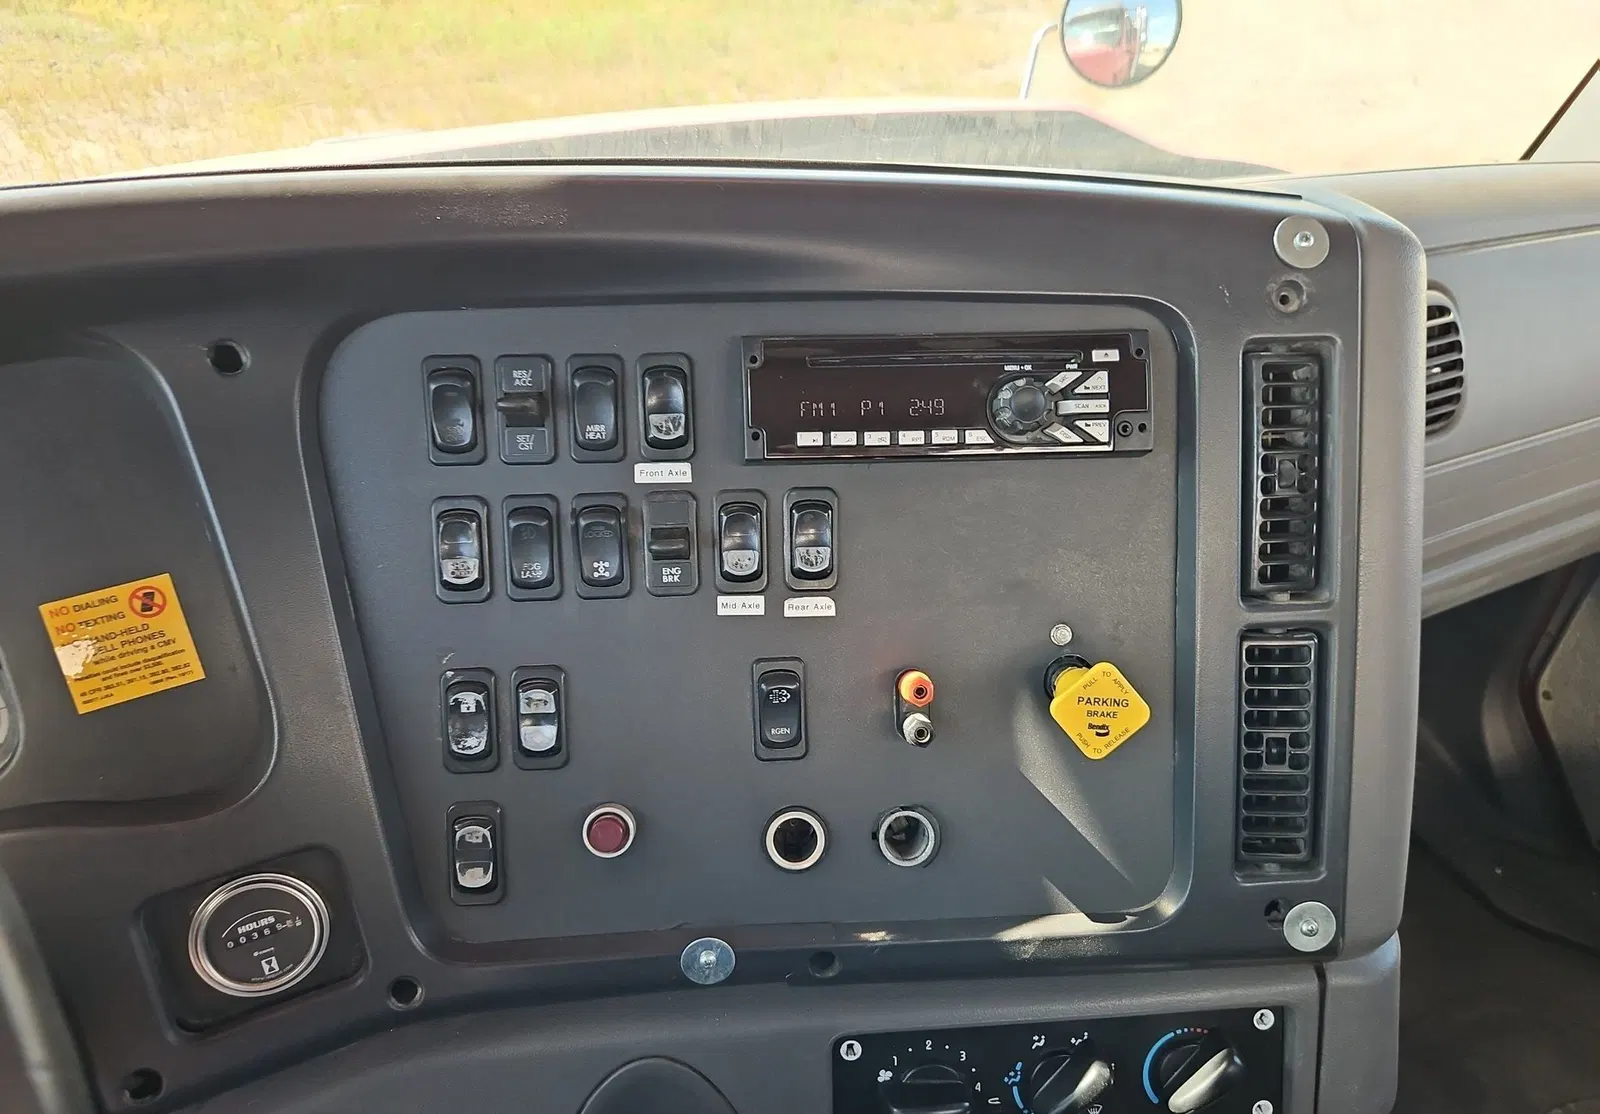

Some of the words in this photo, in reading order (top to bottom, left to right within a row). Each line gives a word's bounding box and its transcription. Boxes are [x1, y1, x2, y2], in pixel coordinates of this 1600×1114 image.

[512, 369, 533, 379] RES/
[513, 378, 533, 387] ACC
[860, 399, 885, 416] P1
[909, 398, 945, 417] 2:49
[516, 434, 535, 443] SET/
[585, 431, 606, 440] HEAT
[517, 442, 534, 451] CST
[639, 469, 664, 477] Front
[667, 469, 688, 477] Axle
[523, 562, 542, 571] FOG
[662, 567, 682, 575] ENG
[662, 575, 681, 583] BRK
[48, 606, 70, 619] NO
[72, 595, 119, 613] DIALING
[721, 601, 737, 610] Mid
[740, 601, 761, 609] Axle
[787, 603, 809, 611] Rear
[813, 603, 833, 611] Axle
[54, 622, 76, 636] NO
[77, 611, 126, 628] TEXTING
[121, 630, 166, 649] PHONES
[118, 647, 149, 661] driving
[157, 637, 176, 648] CMV
[1082, 677, 1098, 690] PULL
[1102, 670, 1112, 678] TO
[1112, 677, 1130, 695] APPLY
[1077, 696, 1129, 708] PARKING
[1086, 710, 1118, 719] BRAKE
[770, 727, 791, 736] RGEN
[1087, 722, 1111, 731] Bendix
[1076, 732, 1091, 749] PUSH
[1104, 727, 1130, 750] RELEASE
[237, 915, 276, 934] HOURS
[925, 1039, 932, 1051] 2
[892, 1055, 898, 1066] 1
[960, 1050, 966, 1061] 3
[974, 1082, 981, 1092] 4
